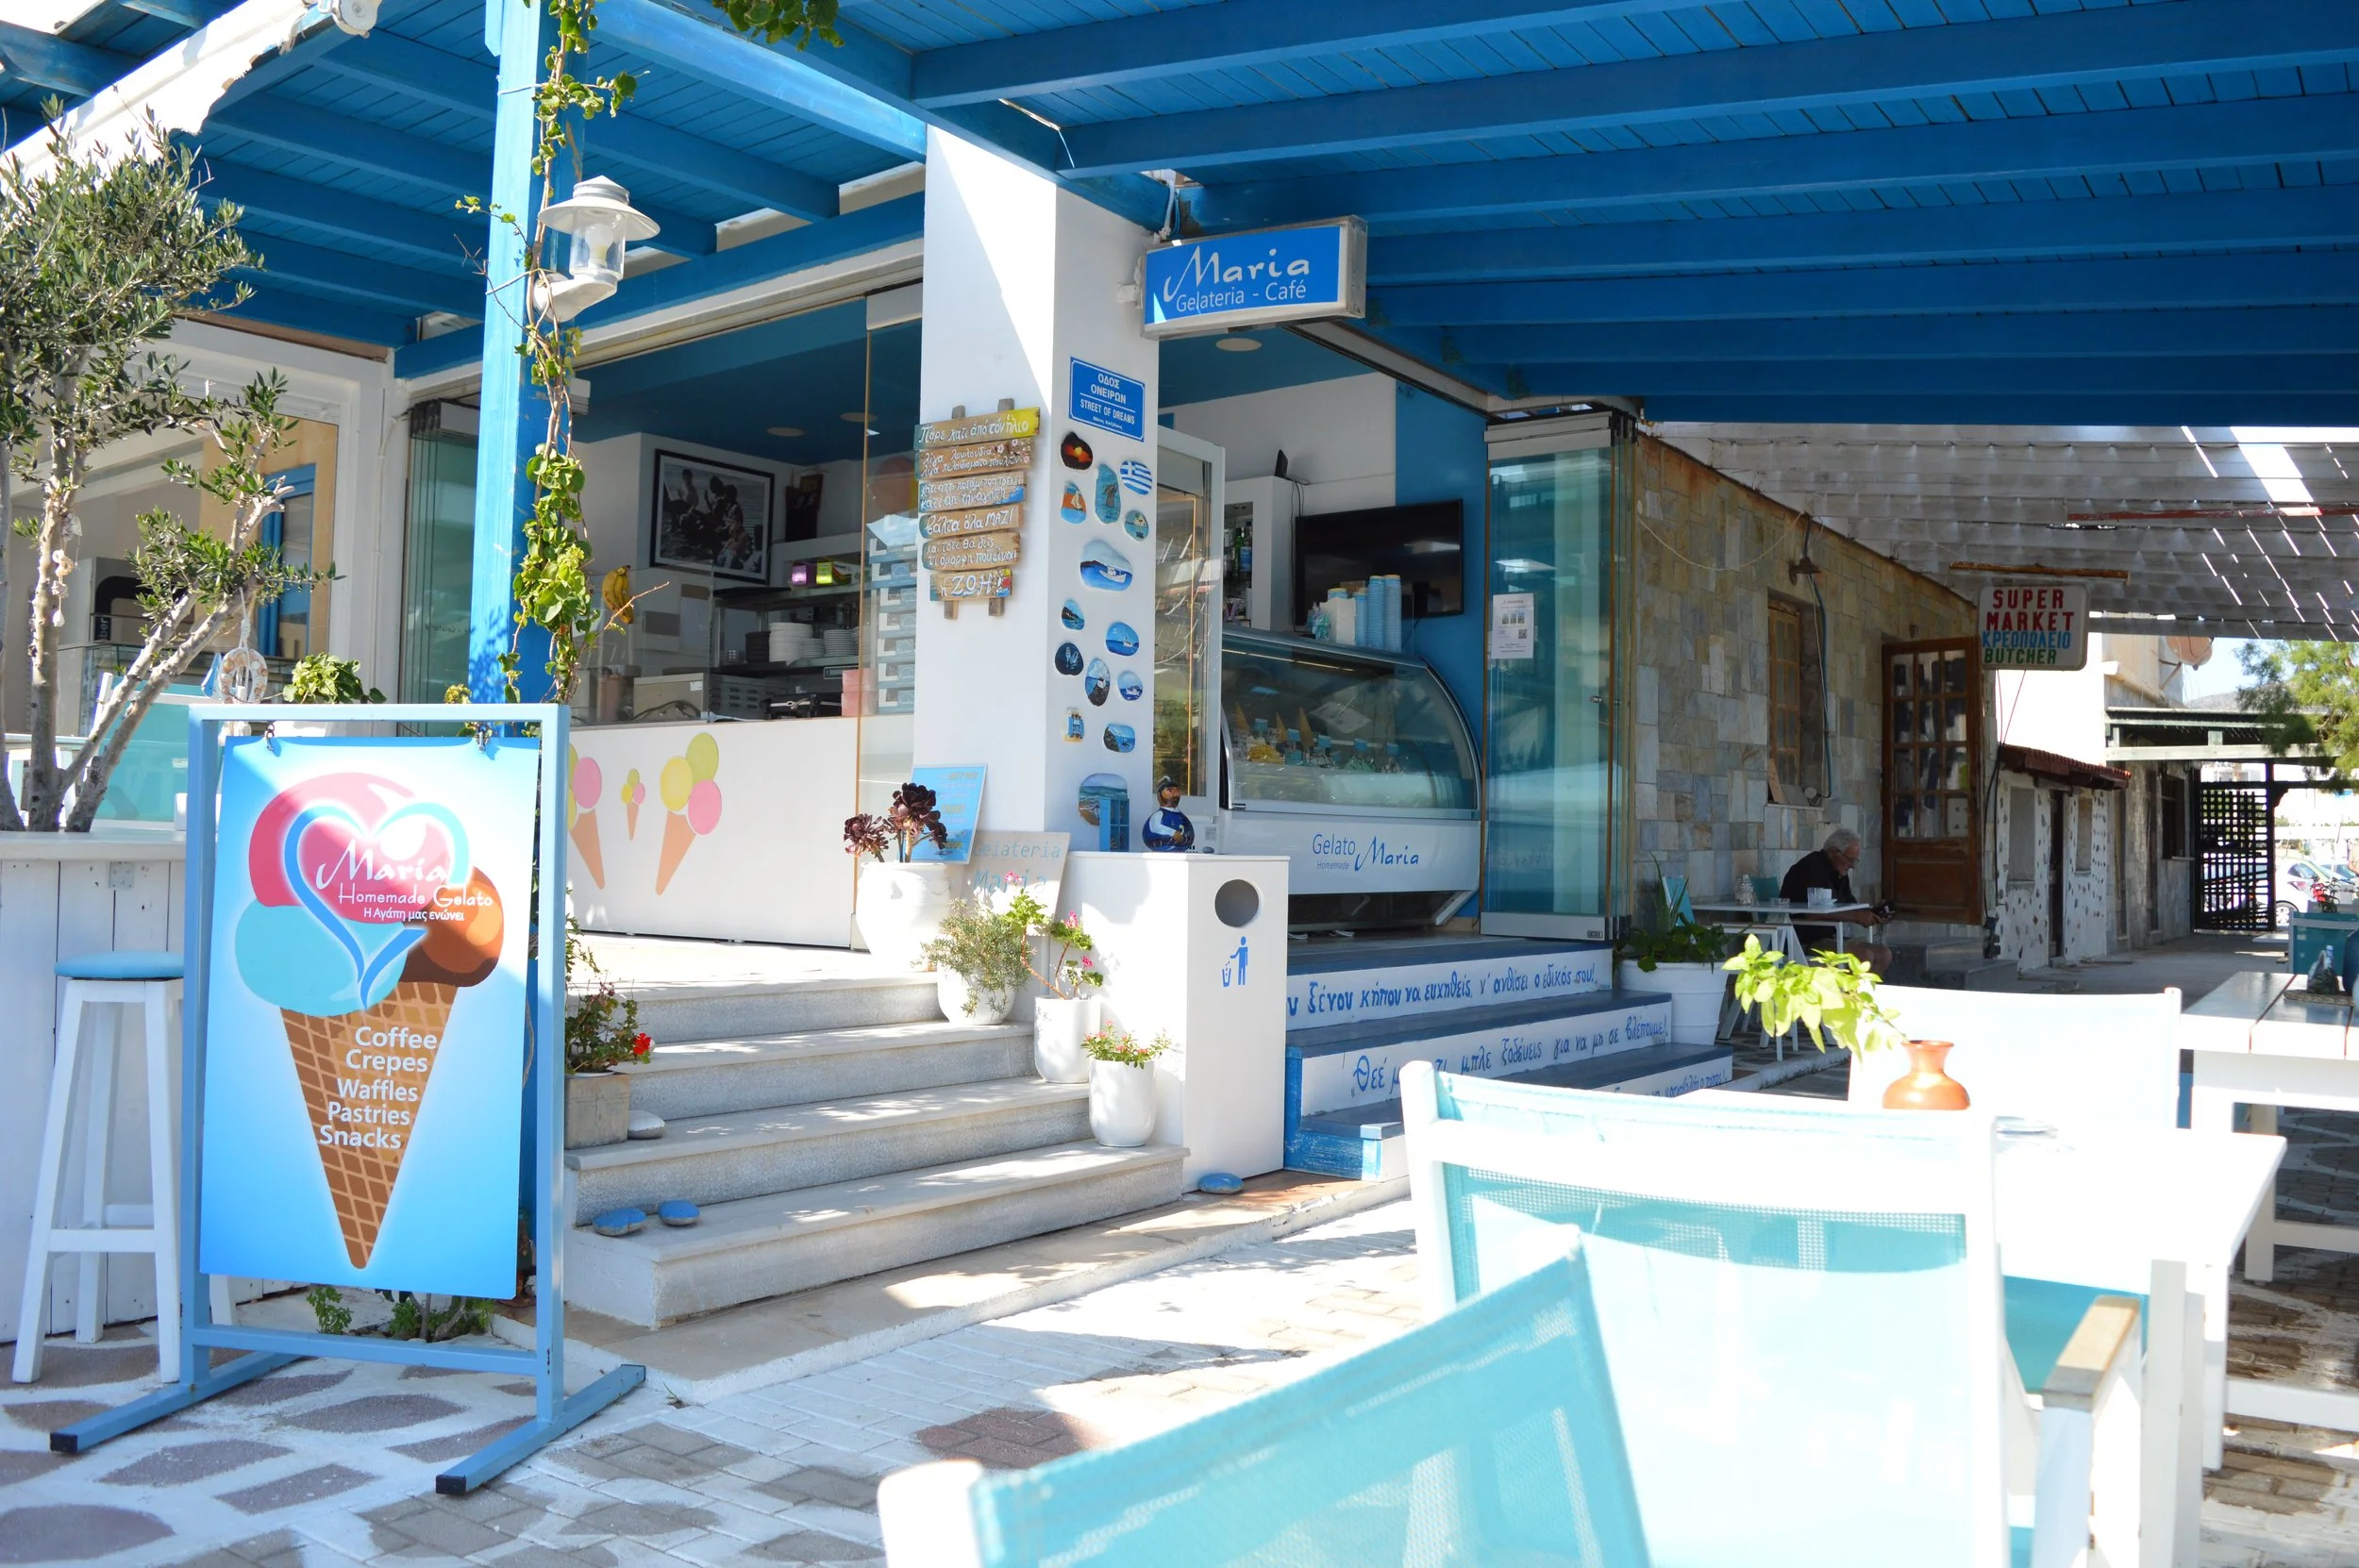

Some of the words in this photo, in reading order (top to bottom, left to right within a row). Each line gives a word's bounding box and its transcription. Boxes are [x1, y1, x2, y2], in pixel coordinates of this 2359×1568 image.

[1163, 245, 1310, 303] Maria
[1177, 287, 1244, 312] Gelateria
[1265, 279, 1307, 301] Café
[1097, 374, 1120, 389] ΟΔΟΣ
[1091, 384, 1127, 405] ΟΝΕΙΡΩΝ
[1079, 399, 1101, 413] STREET
[1103, 405, 1112, 417] OF
[1113, 409, 1135, 425] DREAMS
[1993, 589, 2065, 609] SUPER
[1986, 611, 2075, 631] MARKET
[1982, 630, 2071, 649] ΚΡΕΟΠΩΛΕΙΟ
[1984, 649, 2057, 664] BUTCHER
[315, 840, 448, 890] Maria
[1313, 834, 1356, 856] Gelato
[1354, 836, 1419, 872] Maria
[1317, 860, 1349, 870] Homemade
[338, 883, 426, 905] Homemade
[433, 885, 493, 908] Gelato
[374, 907, 406, 921] Αγάπη
[408, 910, 427, 922] μας
[429, 909, 464, 921] ενώνει
[1308, 980, 1353, 1014] ξένου
[1360, 981, 1401, 1008] κήπου
[1405, 986, 1421, 1003] να
[355, 1026, 437, 1049] Coffee
[345, 1049, 427, 1076] Crepes
[1461, 1045, 1492, 1075] μπλε
[1553, 1038, 1569, 1059] για
[1576, 1038, 1587, 1052] να
[1609, 1027, 1619, 1044] σε
[338, 1078, 418, 1101] Waffles
[327, 1101, 410, 1126] Pastries
[319, 1124, 401, 1149] Snacks
